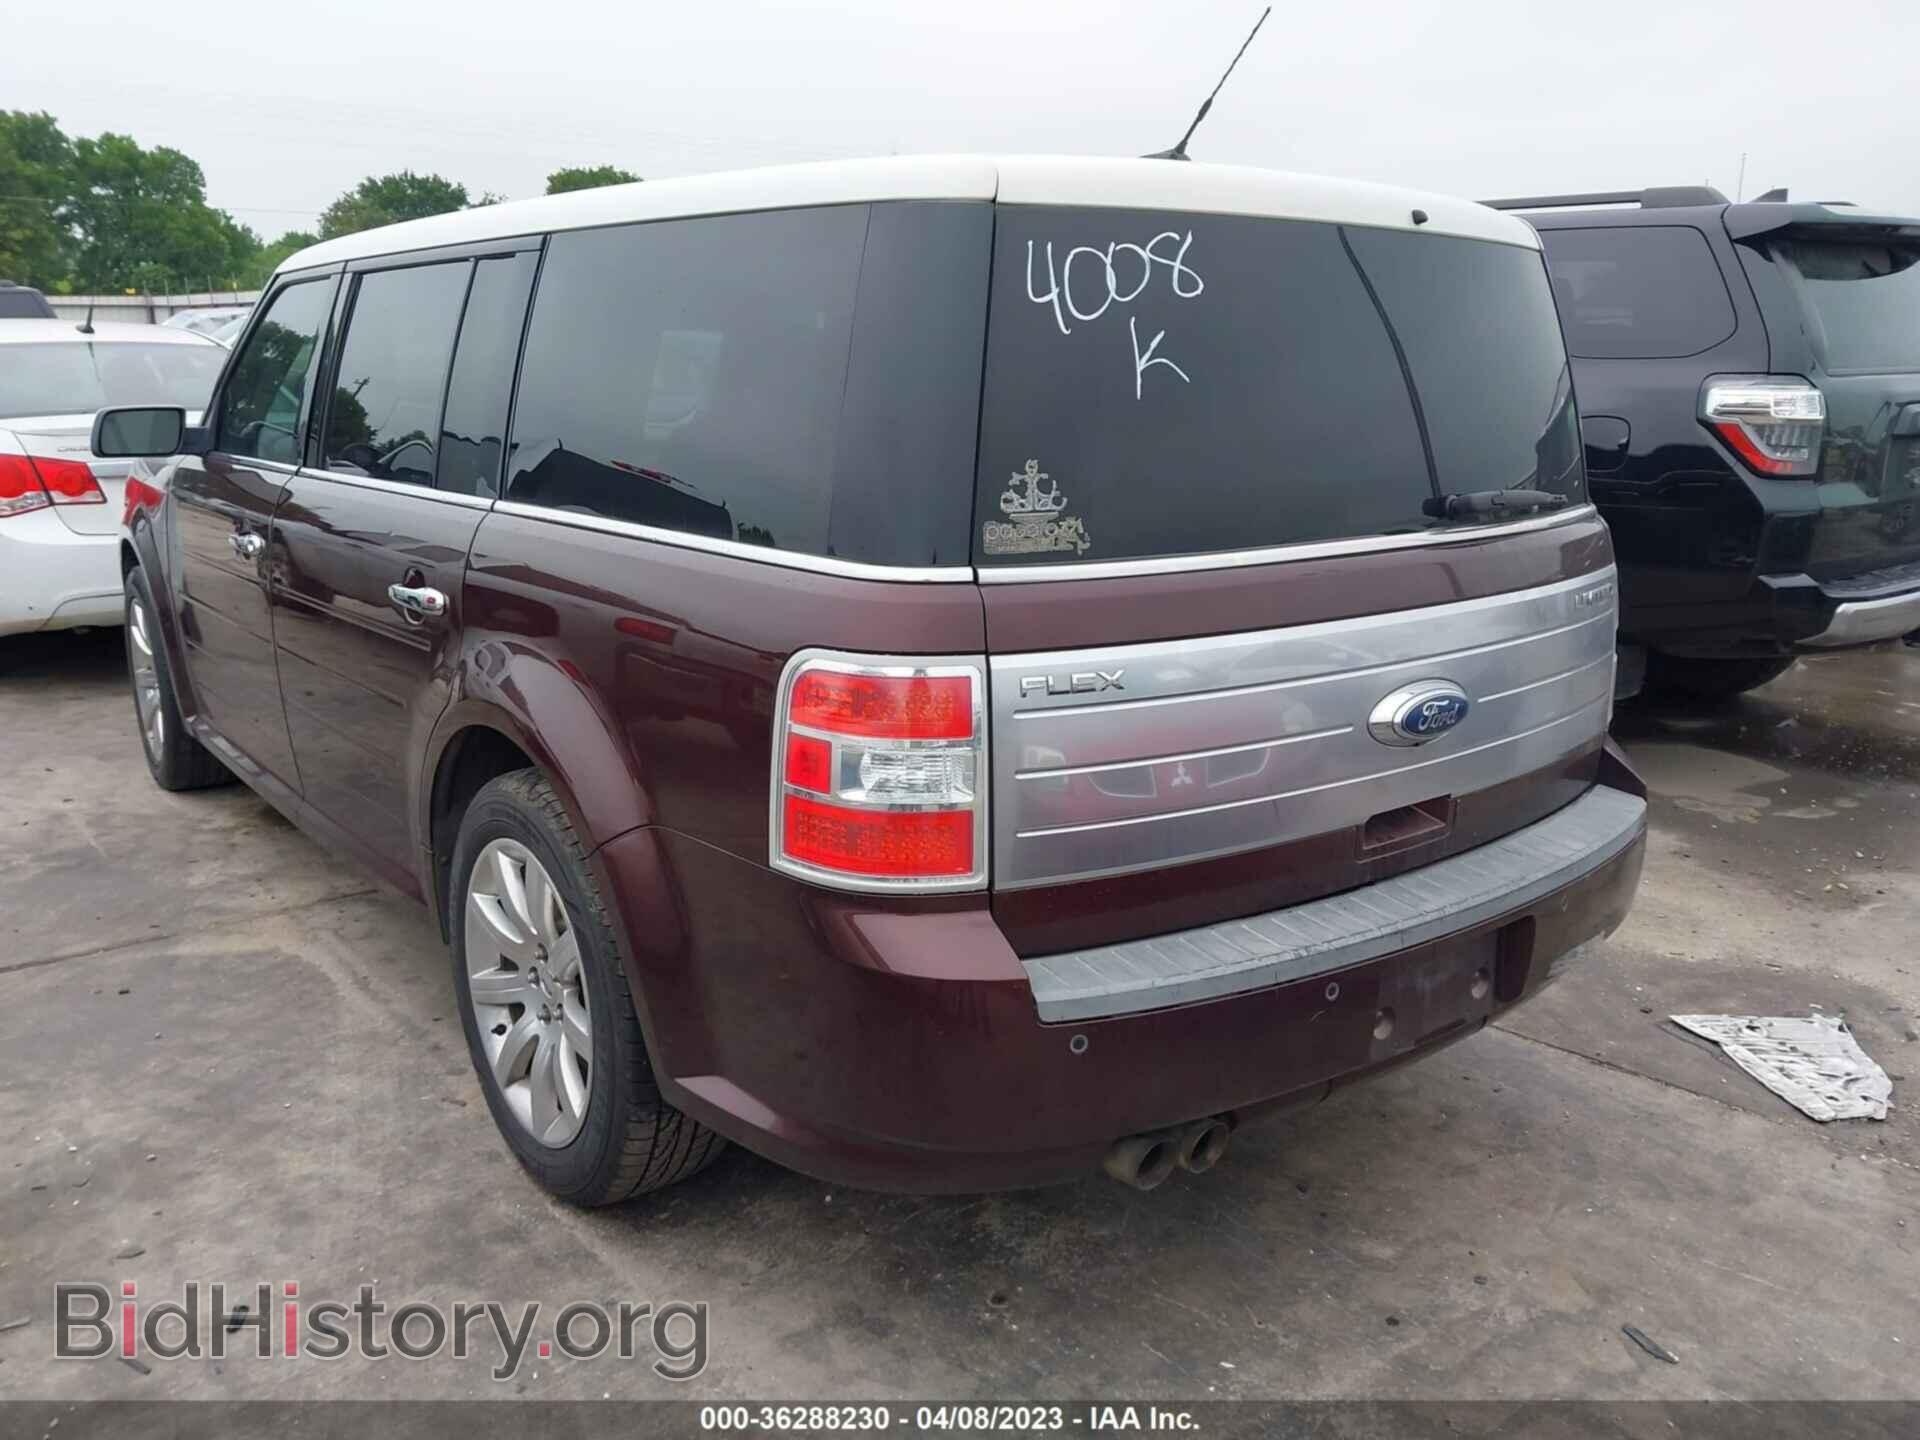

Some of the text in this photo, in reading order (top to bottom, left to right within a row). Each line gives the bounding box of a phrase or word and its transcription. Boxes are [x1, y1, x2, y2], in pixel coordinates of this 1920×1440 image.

[1026, 230, 1205, 335] 4008
[1020, 668, 1125, 698] FLEX
[1418, 699, 1461, 731] Ford
